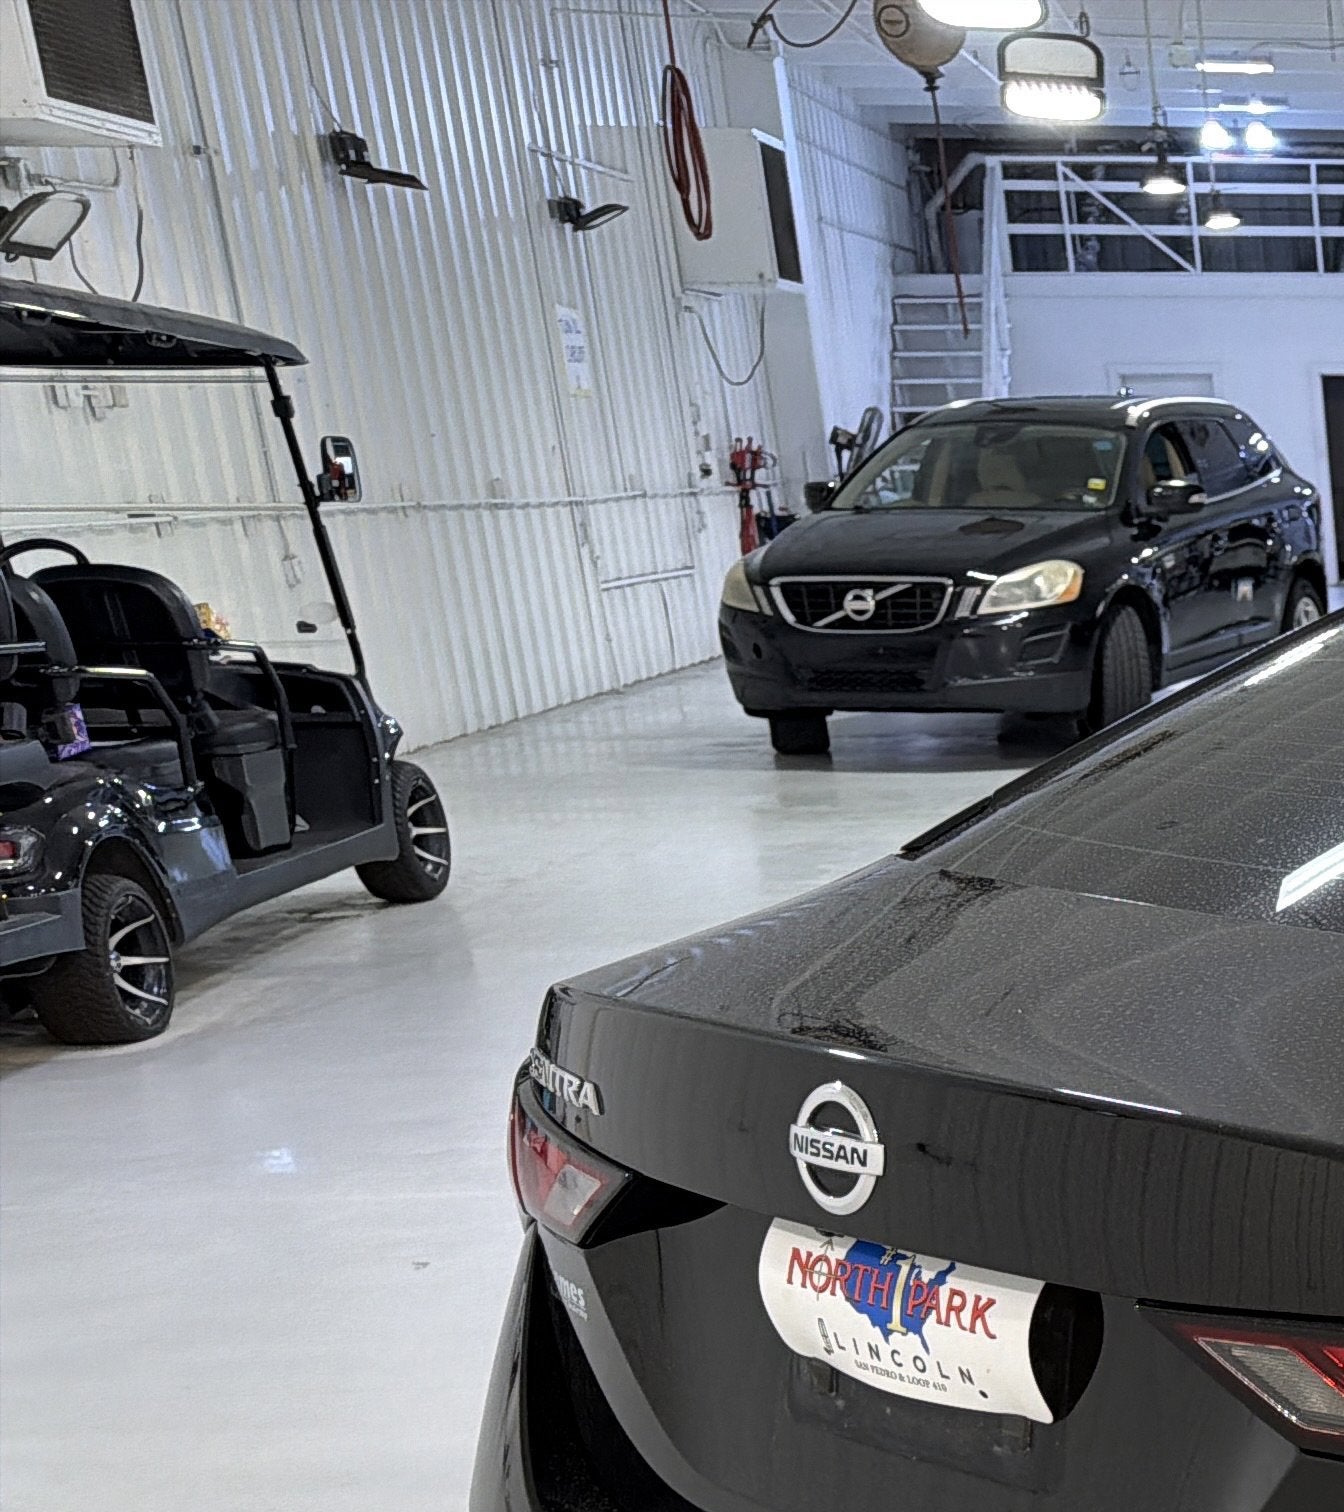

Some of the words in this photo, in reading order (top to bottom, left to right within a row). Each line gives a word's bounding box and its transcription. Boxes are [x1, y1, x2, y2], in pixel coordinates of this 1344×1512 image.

[793, 1132, 868, 1167] NISSAN
[786, 1247, 893, 1310] NORTH
[906, 1280, 997, 1340] PARK
[833, 1332, 975, 1386] LINCOLN
[854, 1359, 869, 1371] SAN
[870, 1364, 898, 1381] PEDRO
[906, 1374, 931, 1389] LOOP
[932, 1380, 948, 1393] 410
